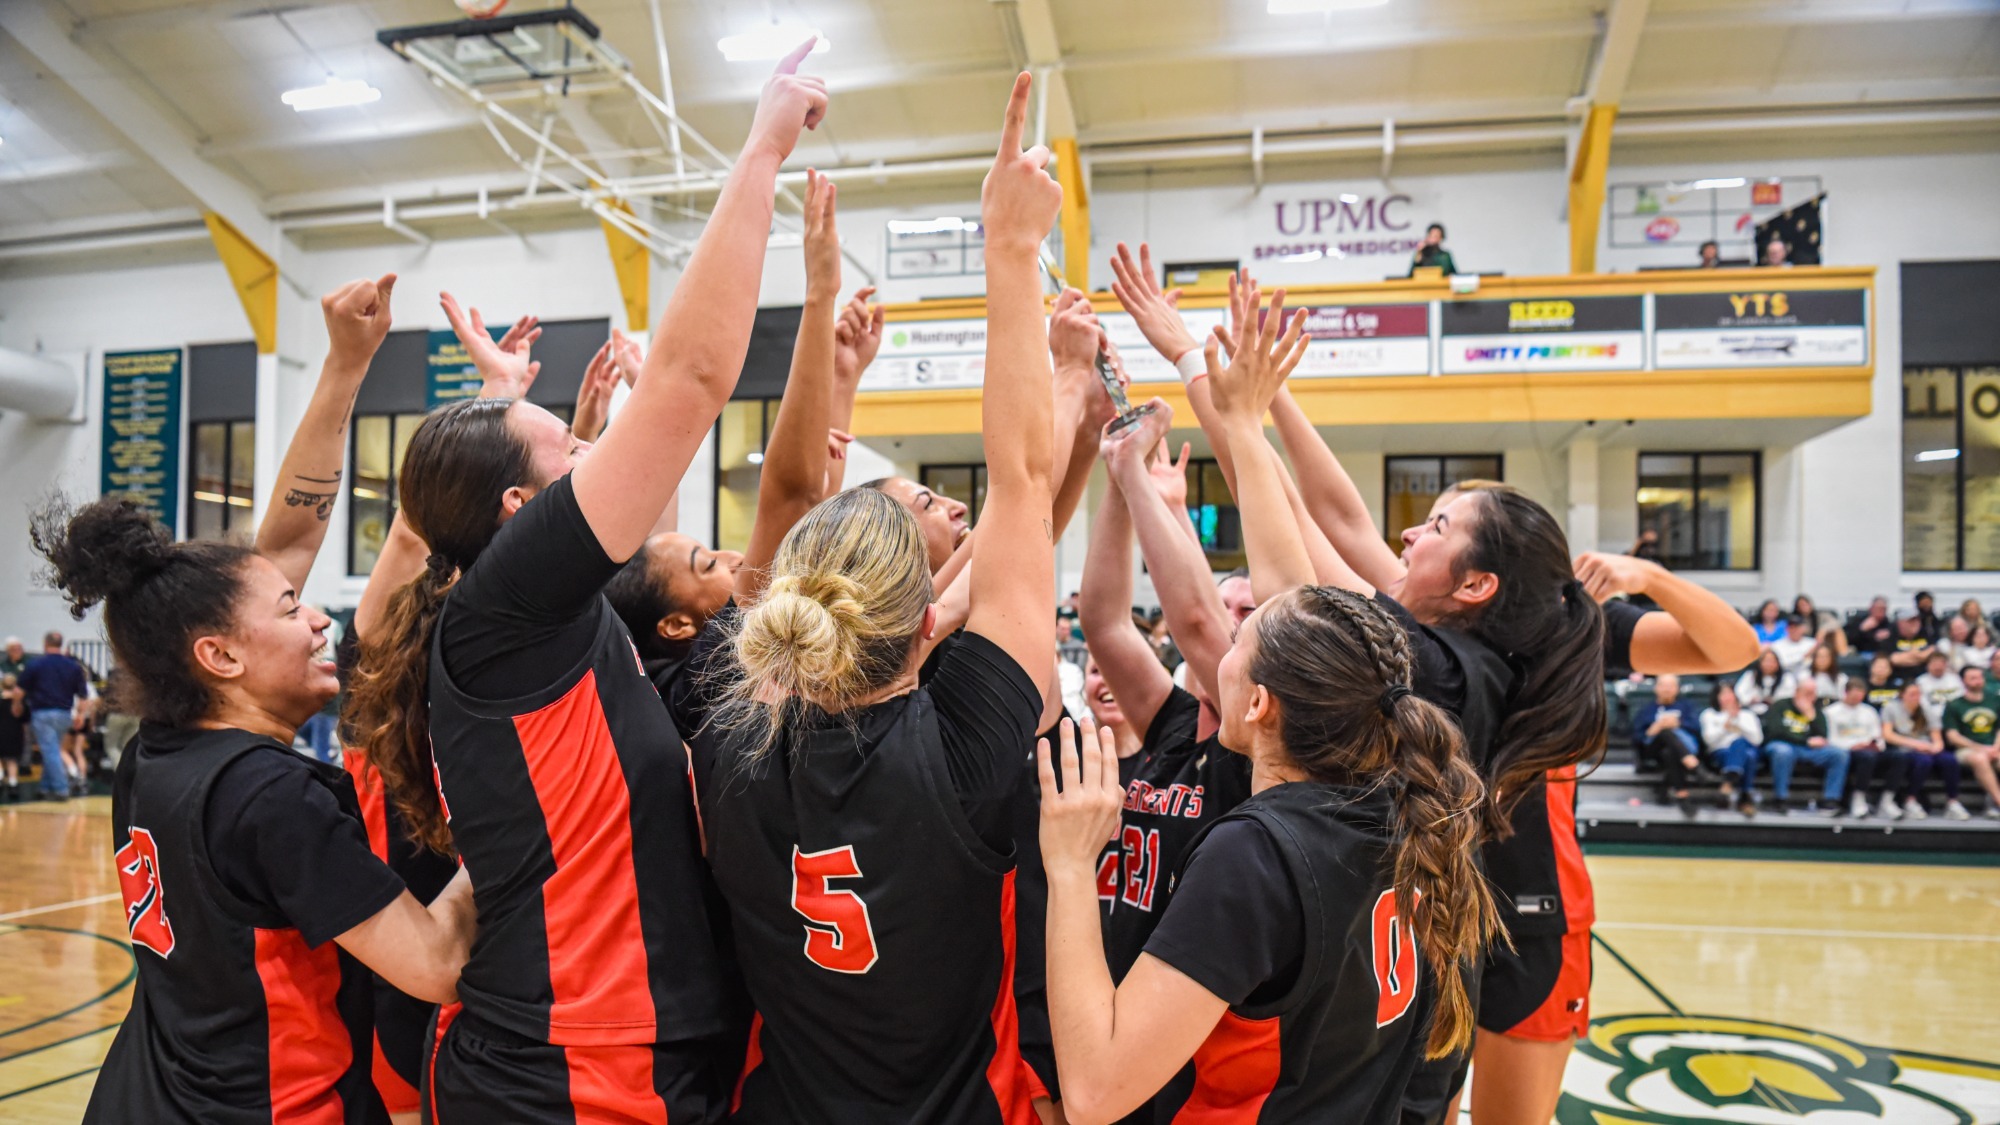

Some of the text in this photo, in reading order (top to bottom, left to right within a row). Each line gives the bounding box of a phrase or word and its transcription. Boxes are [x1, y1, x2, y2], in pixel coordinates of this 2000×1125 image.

[1275, 194, 1413, 236] UPMC
[1254, 238, 1420, 259] SPORTS MEDICIN
[1729, 293, 1789, 317] YTS
[911, 329, 985, 346] Huntington
[1465, 343, 1618, 362] UNITY PRINTING
[1121, 824, 1160, 912] 21
[791, 843, 879, 974] 5
[1371, 886, 1422, 1029] 0
